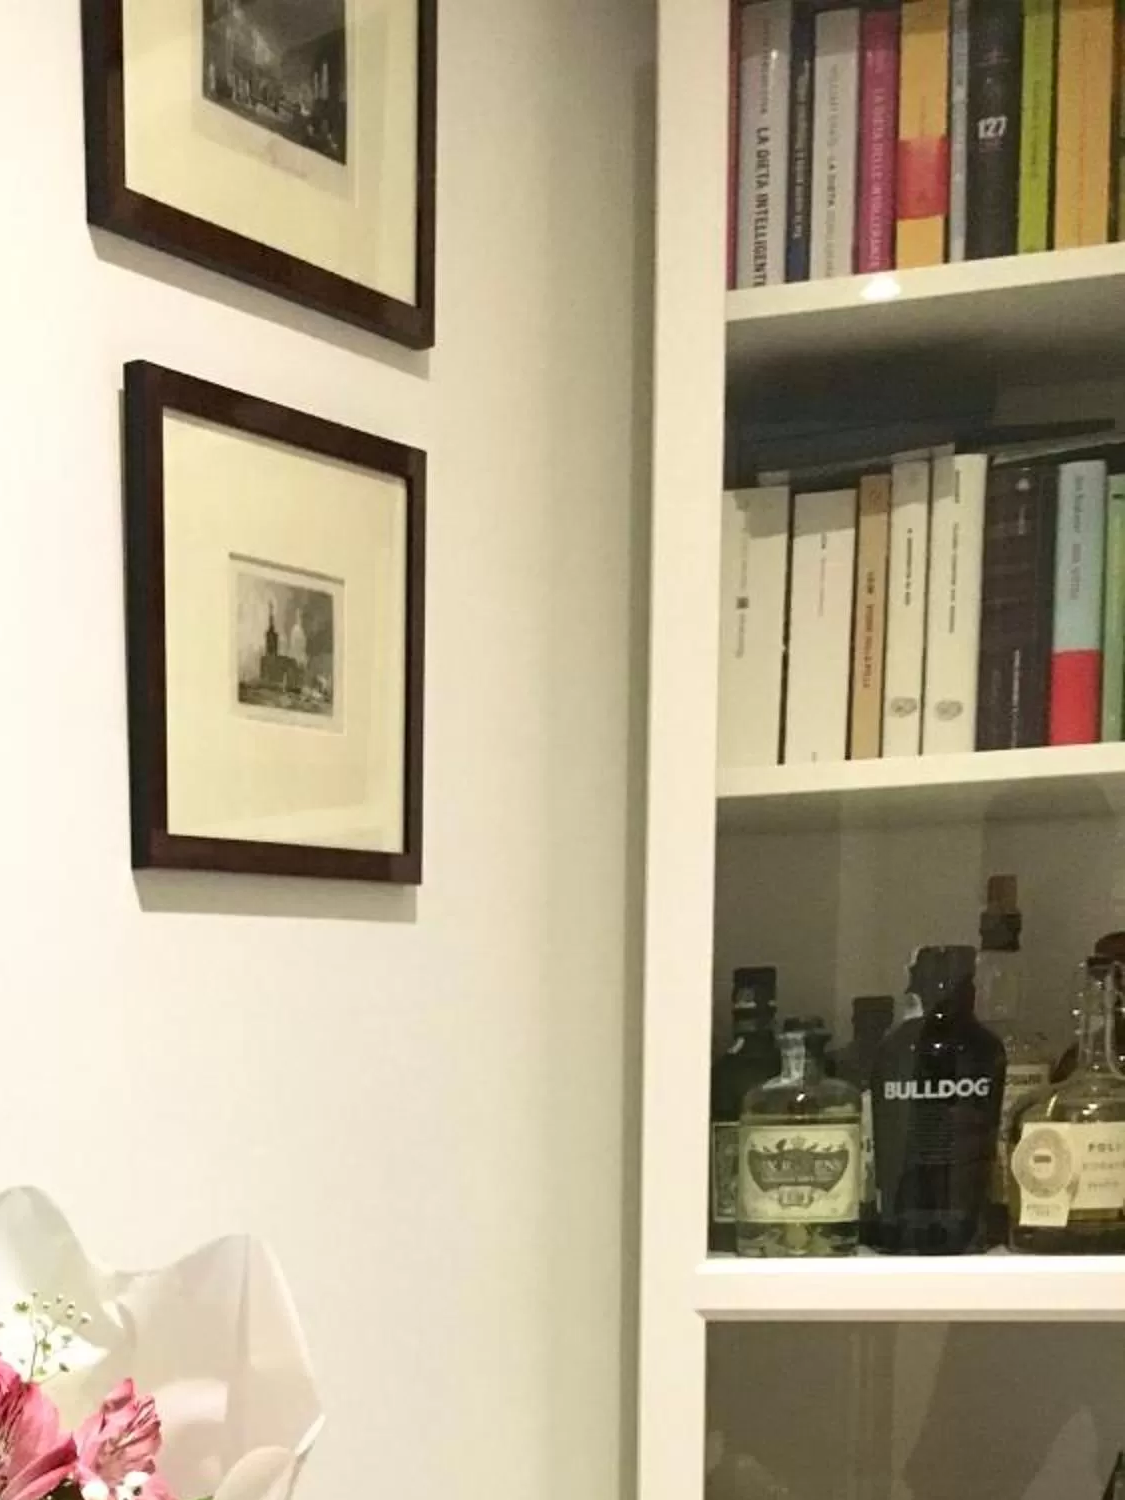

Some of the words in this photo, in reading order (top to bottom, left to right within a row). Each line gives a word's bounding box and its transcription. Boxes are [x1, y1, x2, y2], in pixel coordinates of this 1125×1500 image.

[755, 126, 770, 146] LA
[978, 115, 1007, 139] 127
[754, 149, 770, 189] DIETA
[753, 192, 769, 288] INTELLIGENTE
[883, 1077, 991, 1099] BULLDOG
